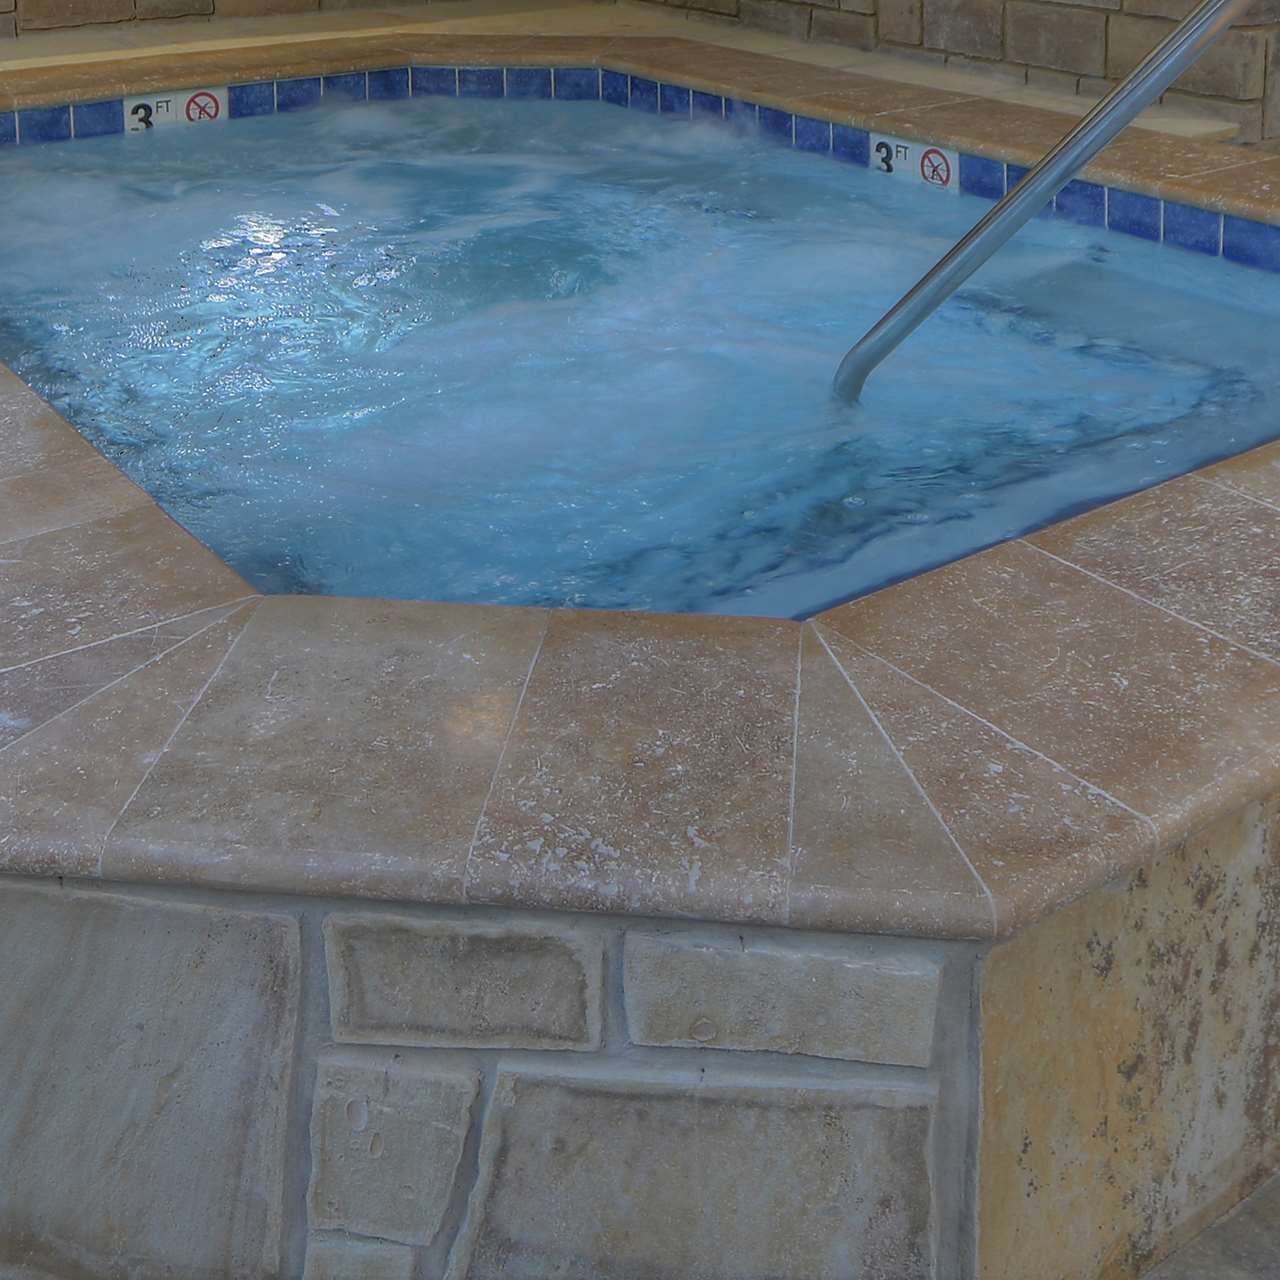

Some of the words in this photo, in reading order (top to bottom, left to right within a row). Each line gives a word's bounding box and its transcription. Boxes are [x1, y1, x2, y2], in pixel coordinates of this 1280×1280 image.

[131, 103, 153, 131] 3
[156, 100, 172, 114] FT
[875, 141, 893, 173] 3
[895, 144, 909, 160] FT
